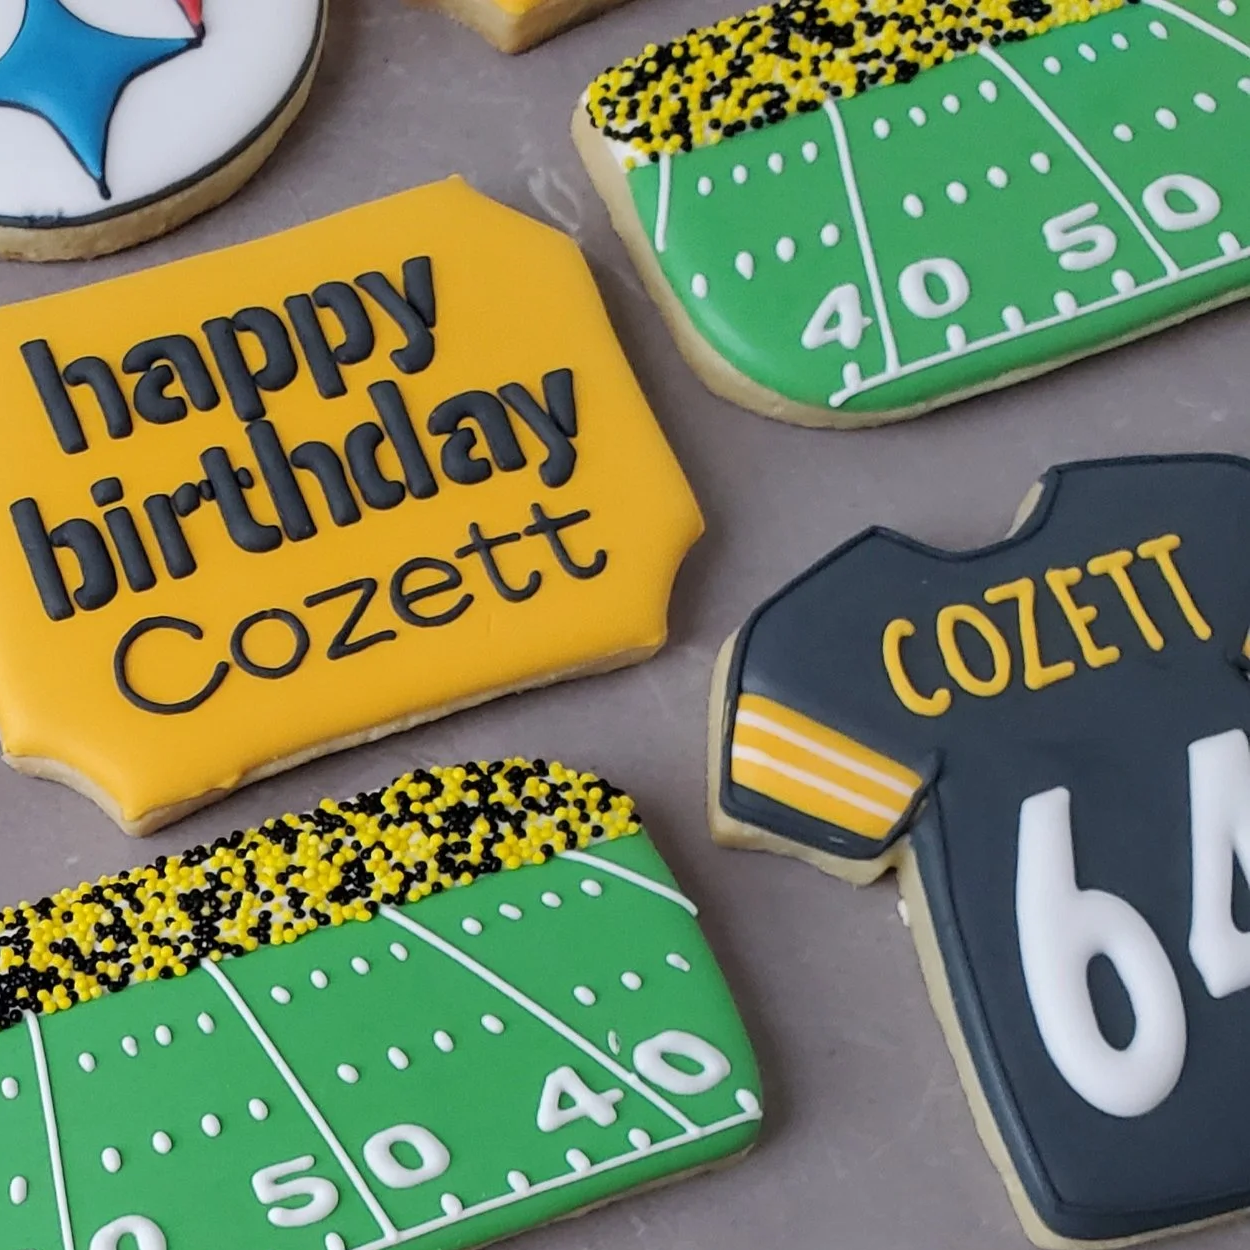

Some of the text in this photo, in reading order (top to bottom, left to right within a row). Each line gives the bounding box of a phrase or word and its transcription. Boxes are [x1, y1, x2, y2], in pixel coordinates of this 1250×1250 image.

[20, 256, 435, 454] happy
[9, 368, 577, 622] birthday
[114, 503, 607, 714] Cozett
[883, 534, 1211, 717] COZETT
